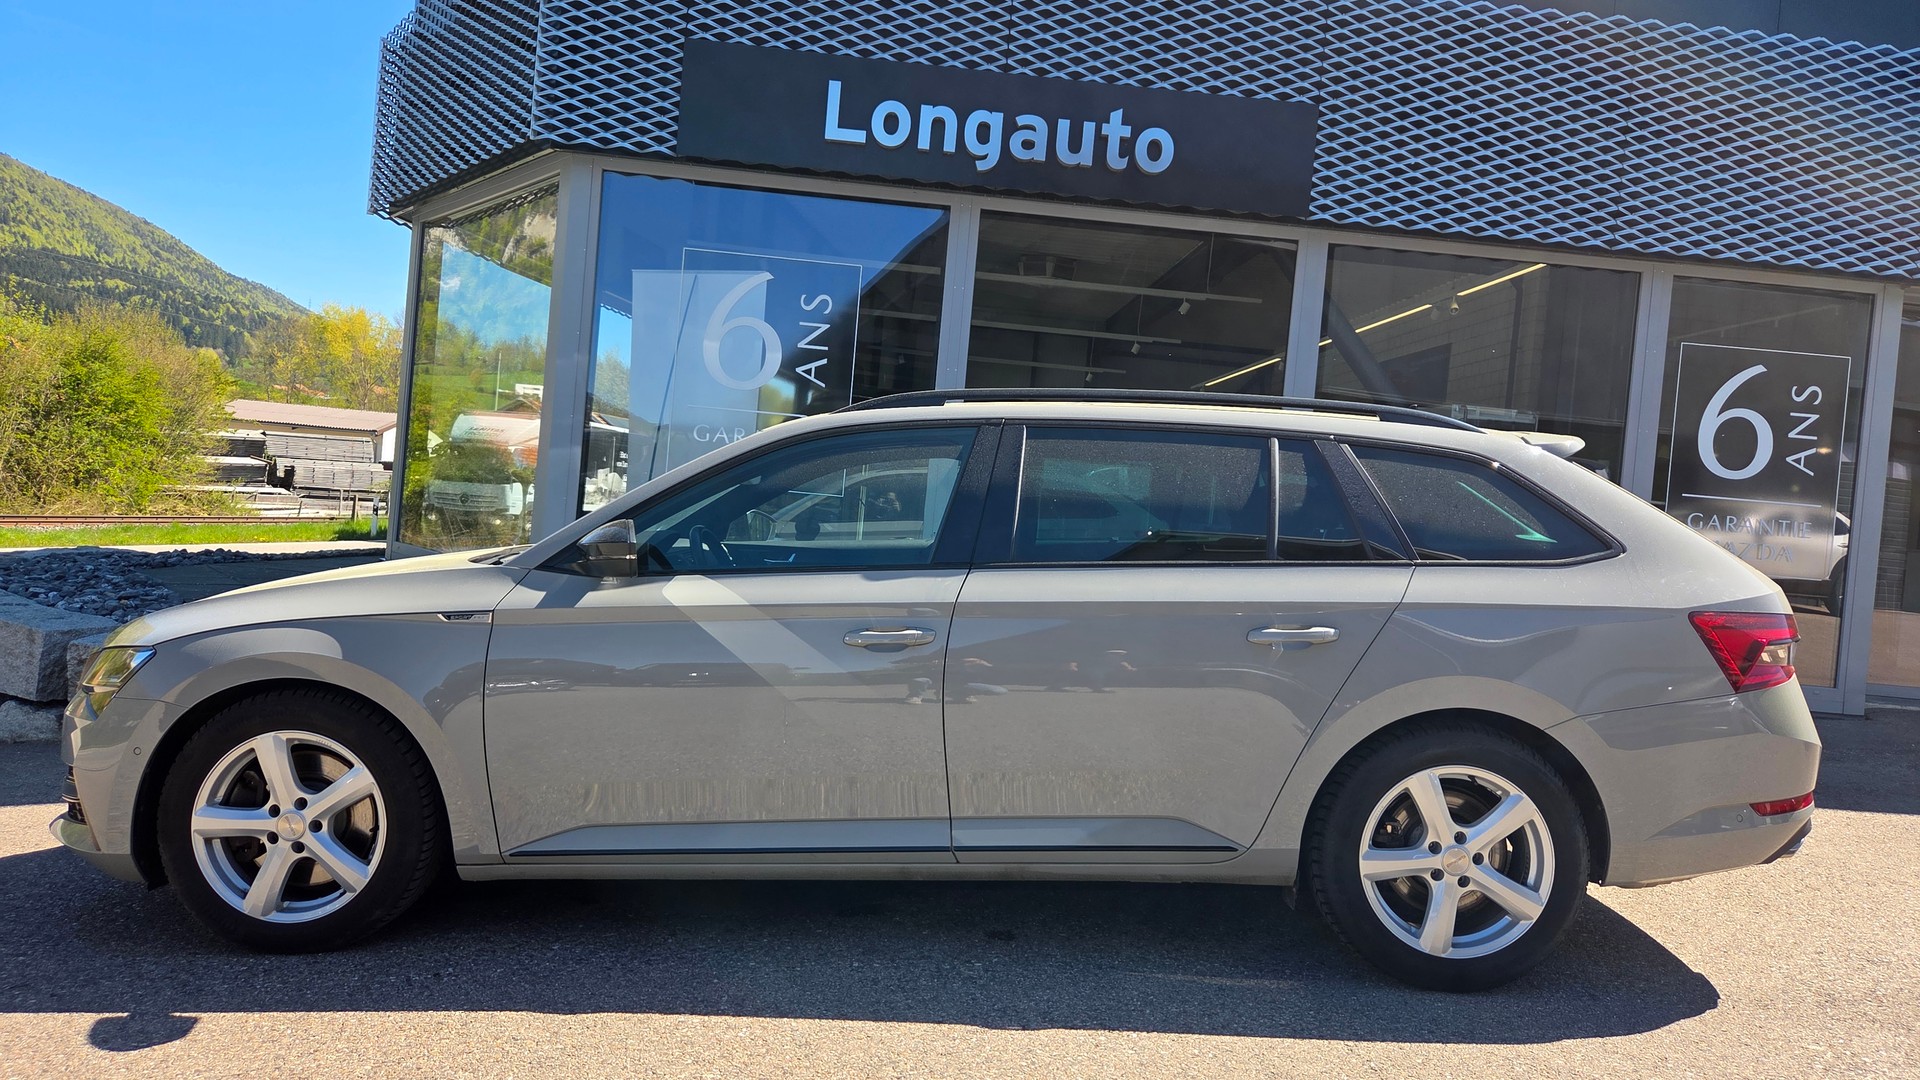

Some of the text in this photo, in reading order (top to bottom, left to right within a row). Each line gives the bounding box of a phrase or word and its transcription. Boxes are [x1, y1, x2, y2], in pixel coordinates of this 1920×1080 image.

[824, 79, 1175, 174] Longauto
[702, 271, 783, 391] 6
[795, 293, 833, 388] ANS
[1697, 364, 1774, 480] 6
[1785, 385, 1822, 477] ANS
[1687, 512, 1813, 539] GARANTIE
[1714, 540, 1793, 563] AZDA
